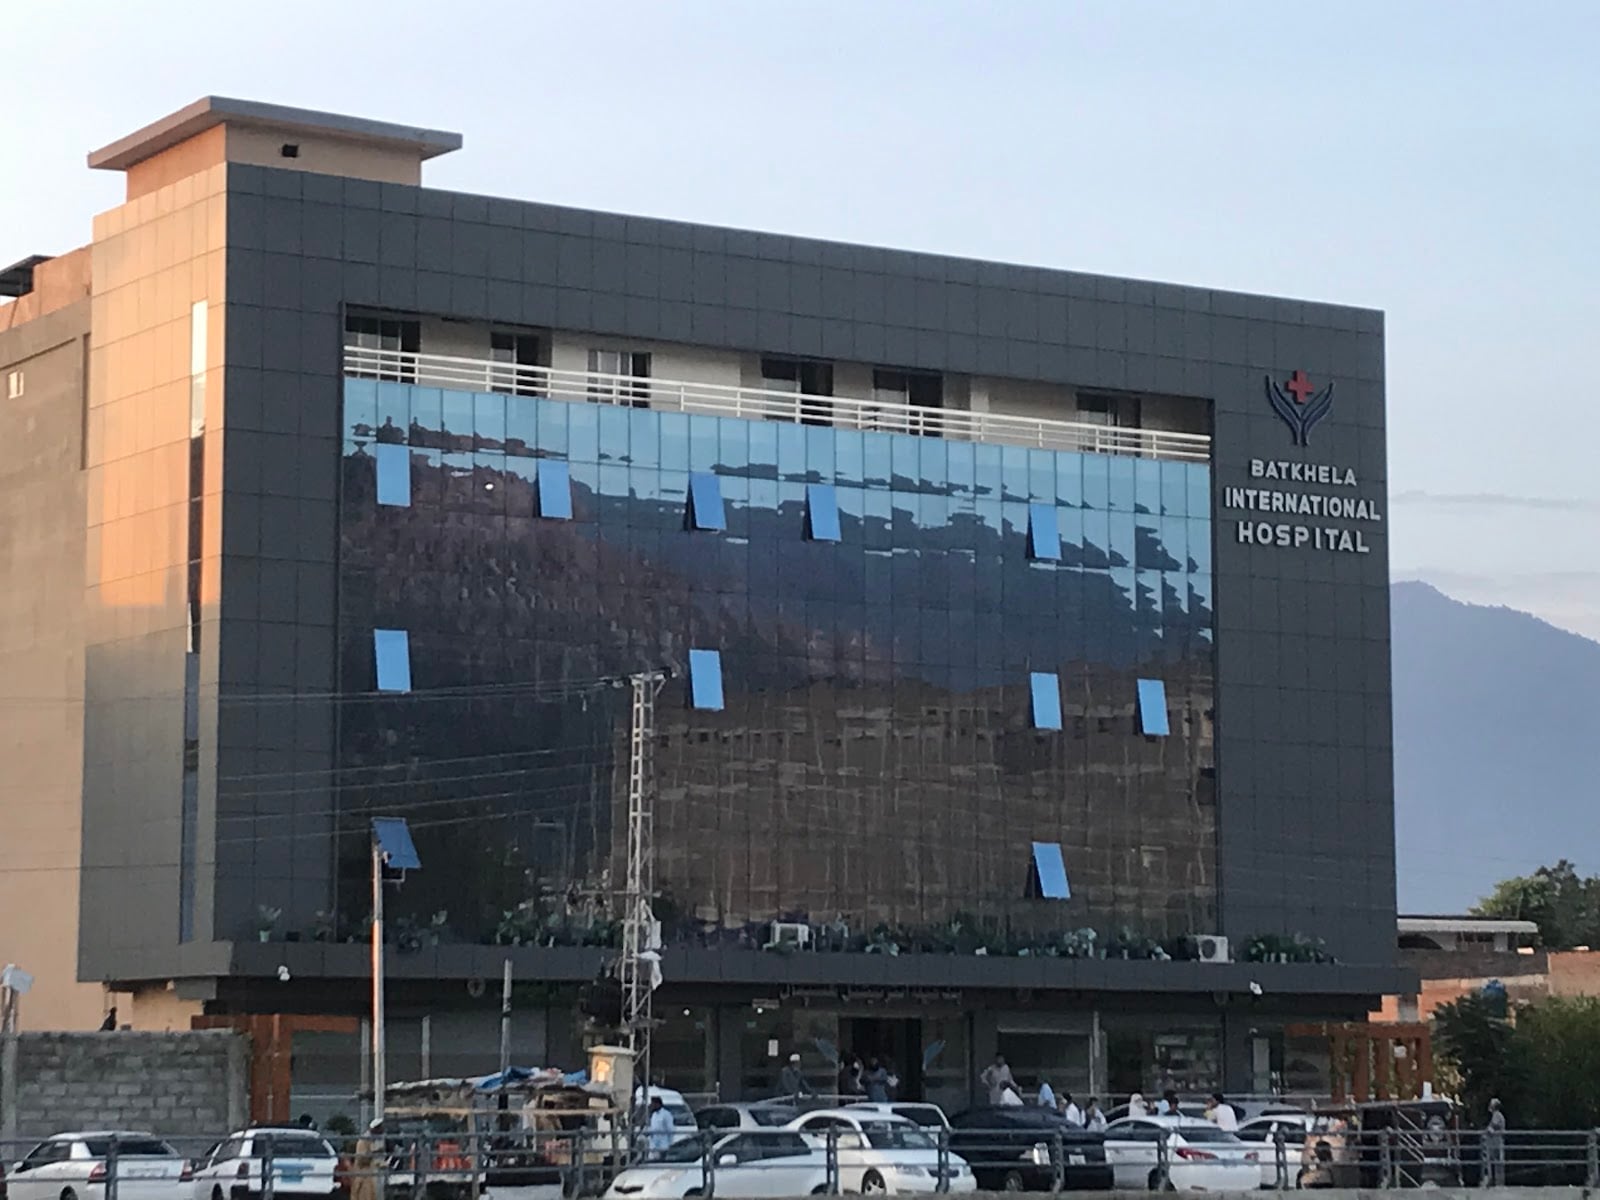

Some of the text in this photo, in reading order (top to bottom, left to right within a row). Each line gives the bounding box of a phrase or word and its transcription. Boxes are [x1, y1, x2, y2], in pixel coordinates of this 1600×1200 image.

[1251, 459, 1357, 486] BATKHELA
[1225, 487, 1381, 520] INTERNATIONAL
[1238, 521, 1370, 552] HOSPITAL
